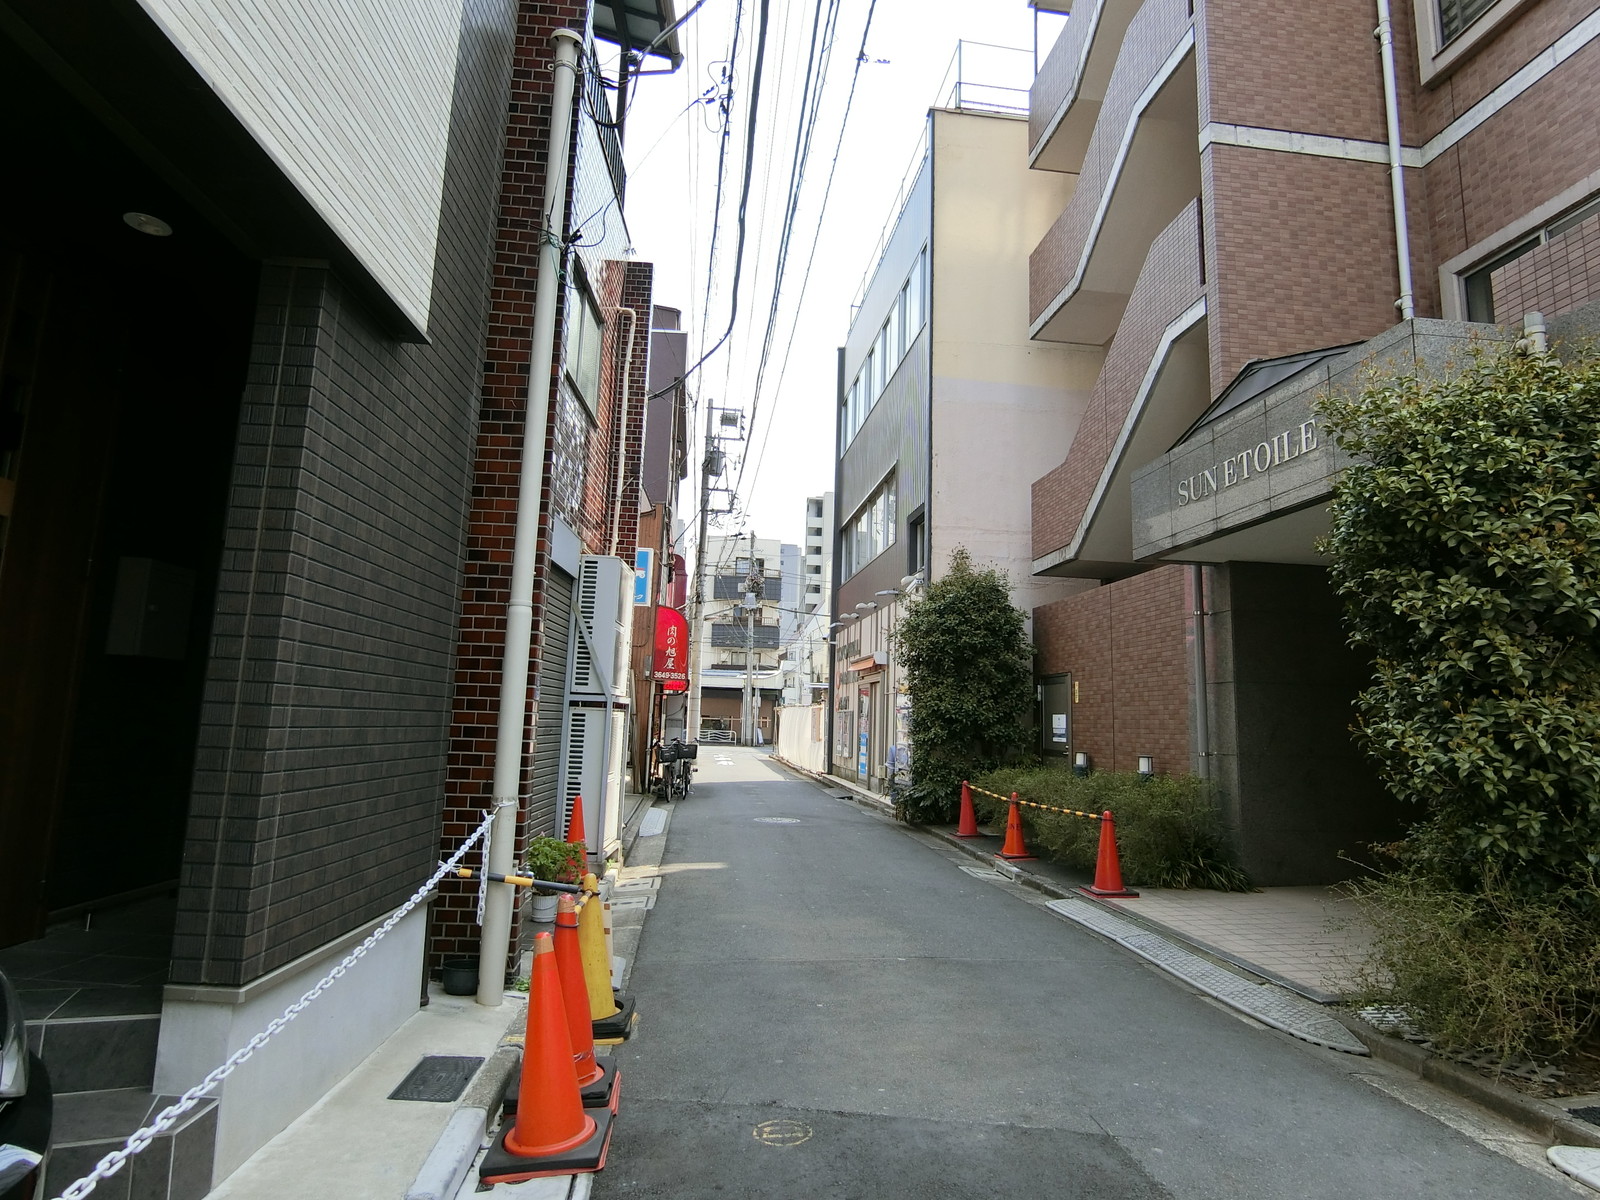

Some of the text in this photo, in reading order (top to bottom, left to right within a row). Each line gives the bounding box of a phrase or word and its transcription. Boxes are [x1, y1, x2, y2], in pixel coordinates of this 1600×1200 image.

[1178, 419, 1318, 506] SUN ETOILE
[663, 625, 677, 669] 肉の旭屋
